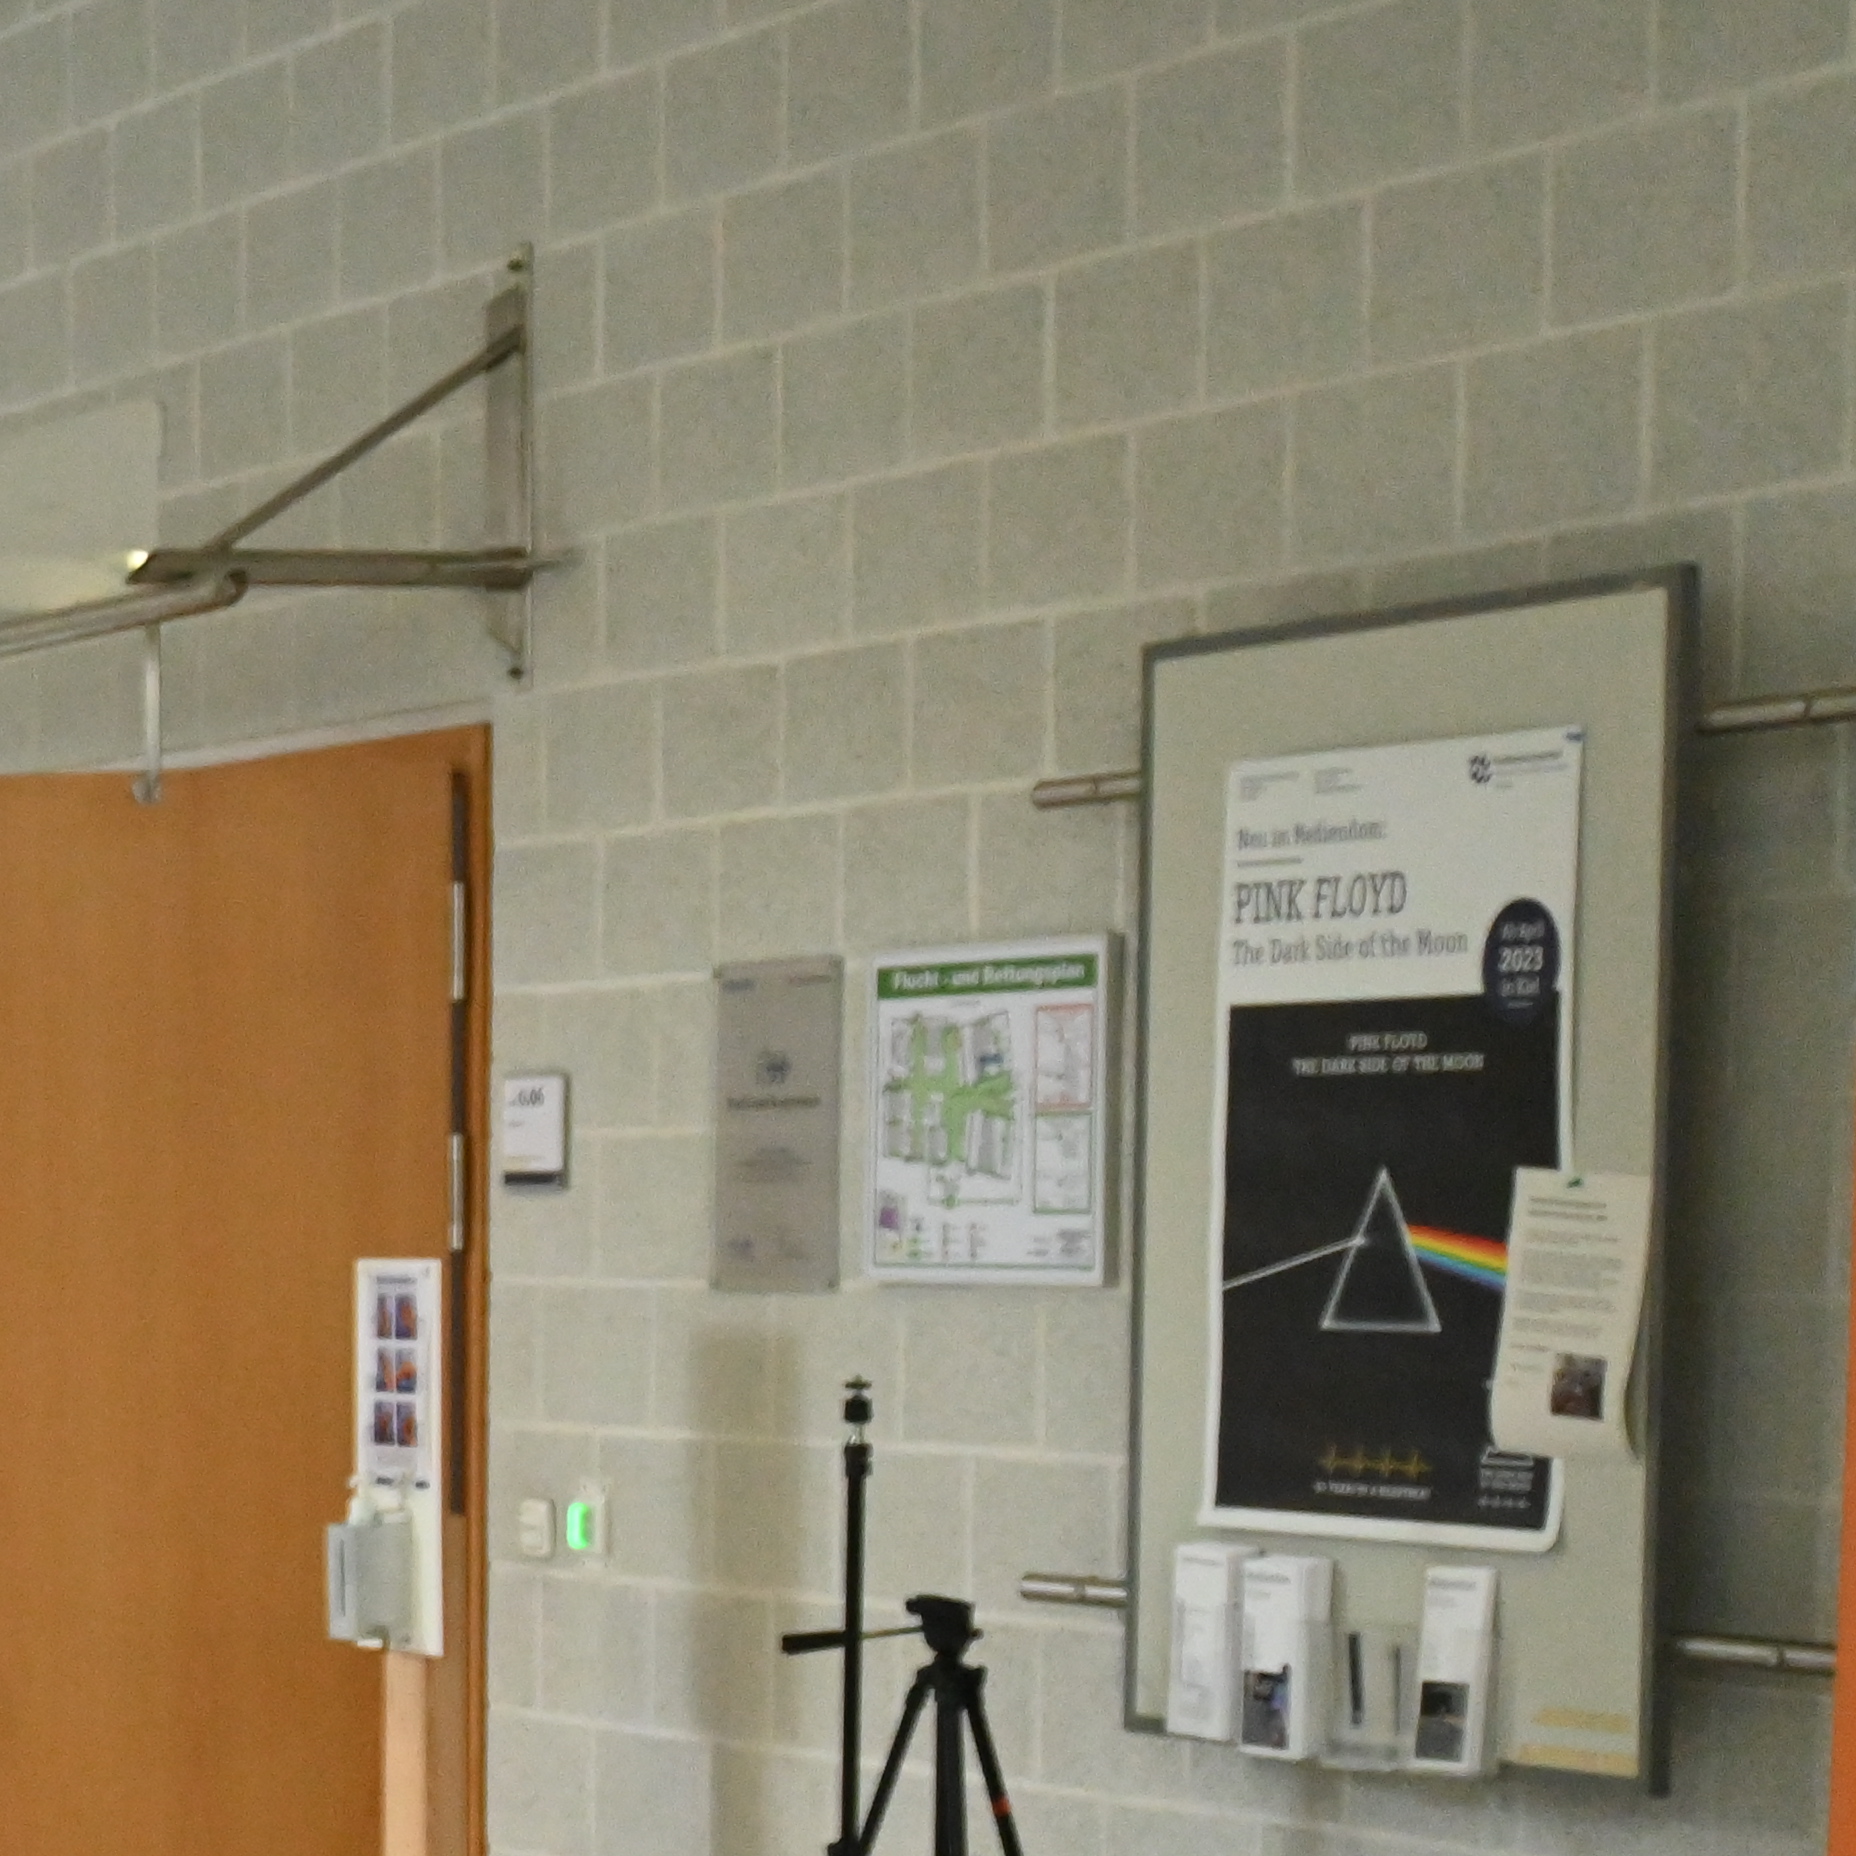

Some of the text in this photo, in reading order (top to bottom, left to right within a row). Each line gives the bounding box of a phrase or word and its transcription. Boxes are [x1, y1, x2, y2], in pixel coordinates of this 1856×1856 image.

[1234, 870, 1408, 924] PINK FLOYD
[1233, 927, 1469, 966] The Dark Side of the Moon
[1497, 946, 1544, 972] 2023
[1383, 1031, 1428, 1050] FLOYD
[1321, 1056, 1356, 1074] DARK
[1358, 1056, 1387, 1073] SIDE
[1442, 1052, 1485, 1071] MOON
